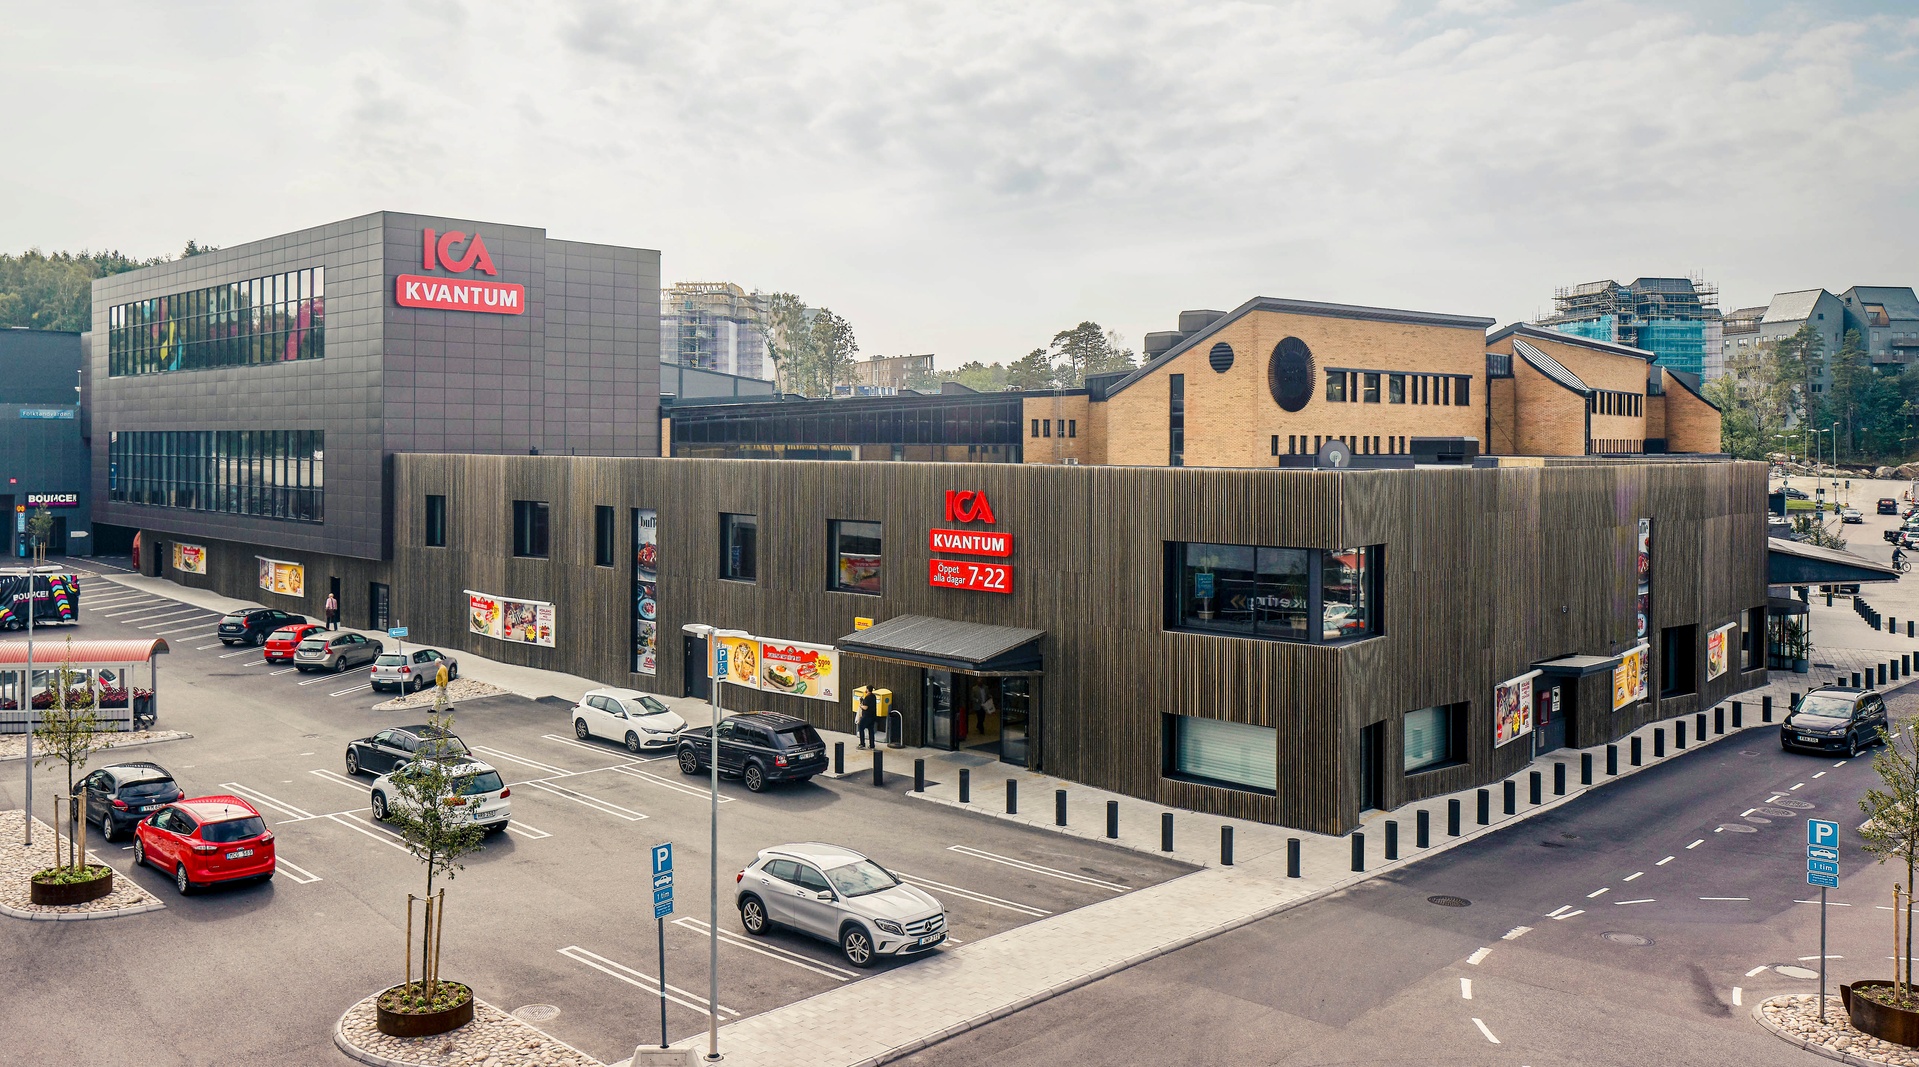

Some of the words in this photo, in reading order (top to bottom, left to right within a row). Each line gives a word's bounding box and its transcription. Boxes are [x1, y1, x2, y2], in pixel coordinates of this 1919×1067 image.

[423, 228, 498, 276] ICA
[406, 281, 518, 307] KVANTUM
[945, 490, 996, 524] ICA
[933, 533, 1005, 552] KVANTUM
[933, 573, 945, 582] alla
[946, 575, 966, 586] dagar
[937, 562, 960, 574] Öppet
[968, 566, 1005, 589] 7-22
[720, 650, 726, 661] P
[1816, 823, 1833, 844] P
[657, 847, 669, 871] P
[1819, 863, 1833, 871] tim
